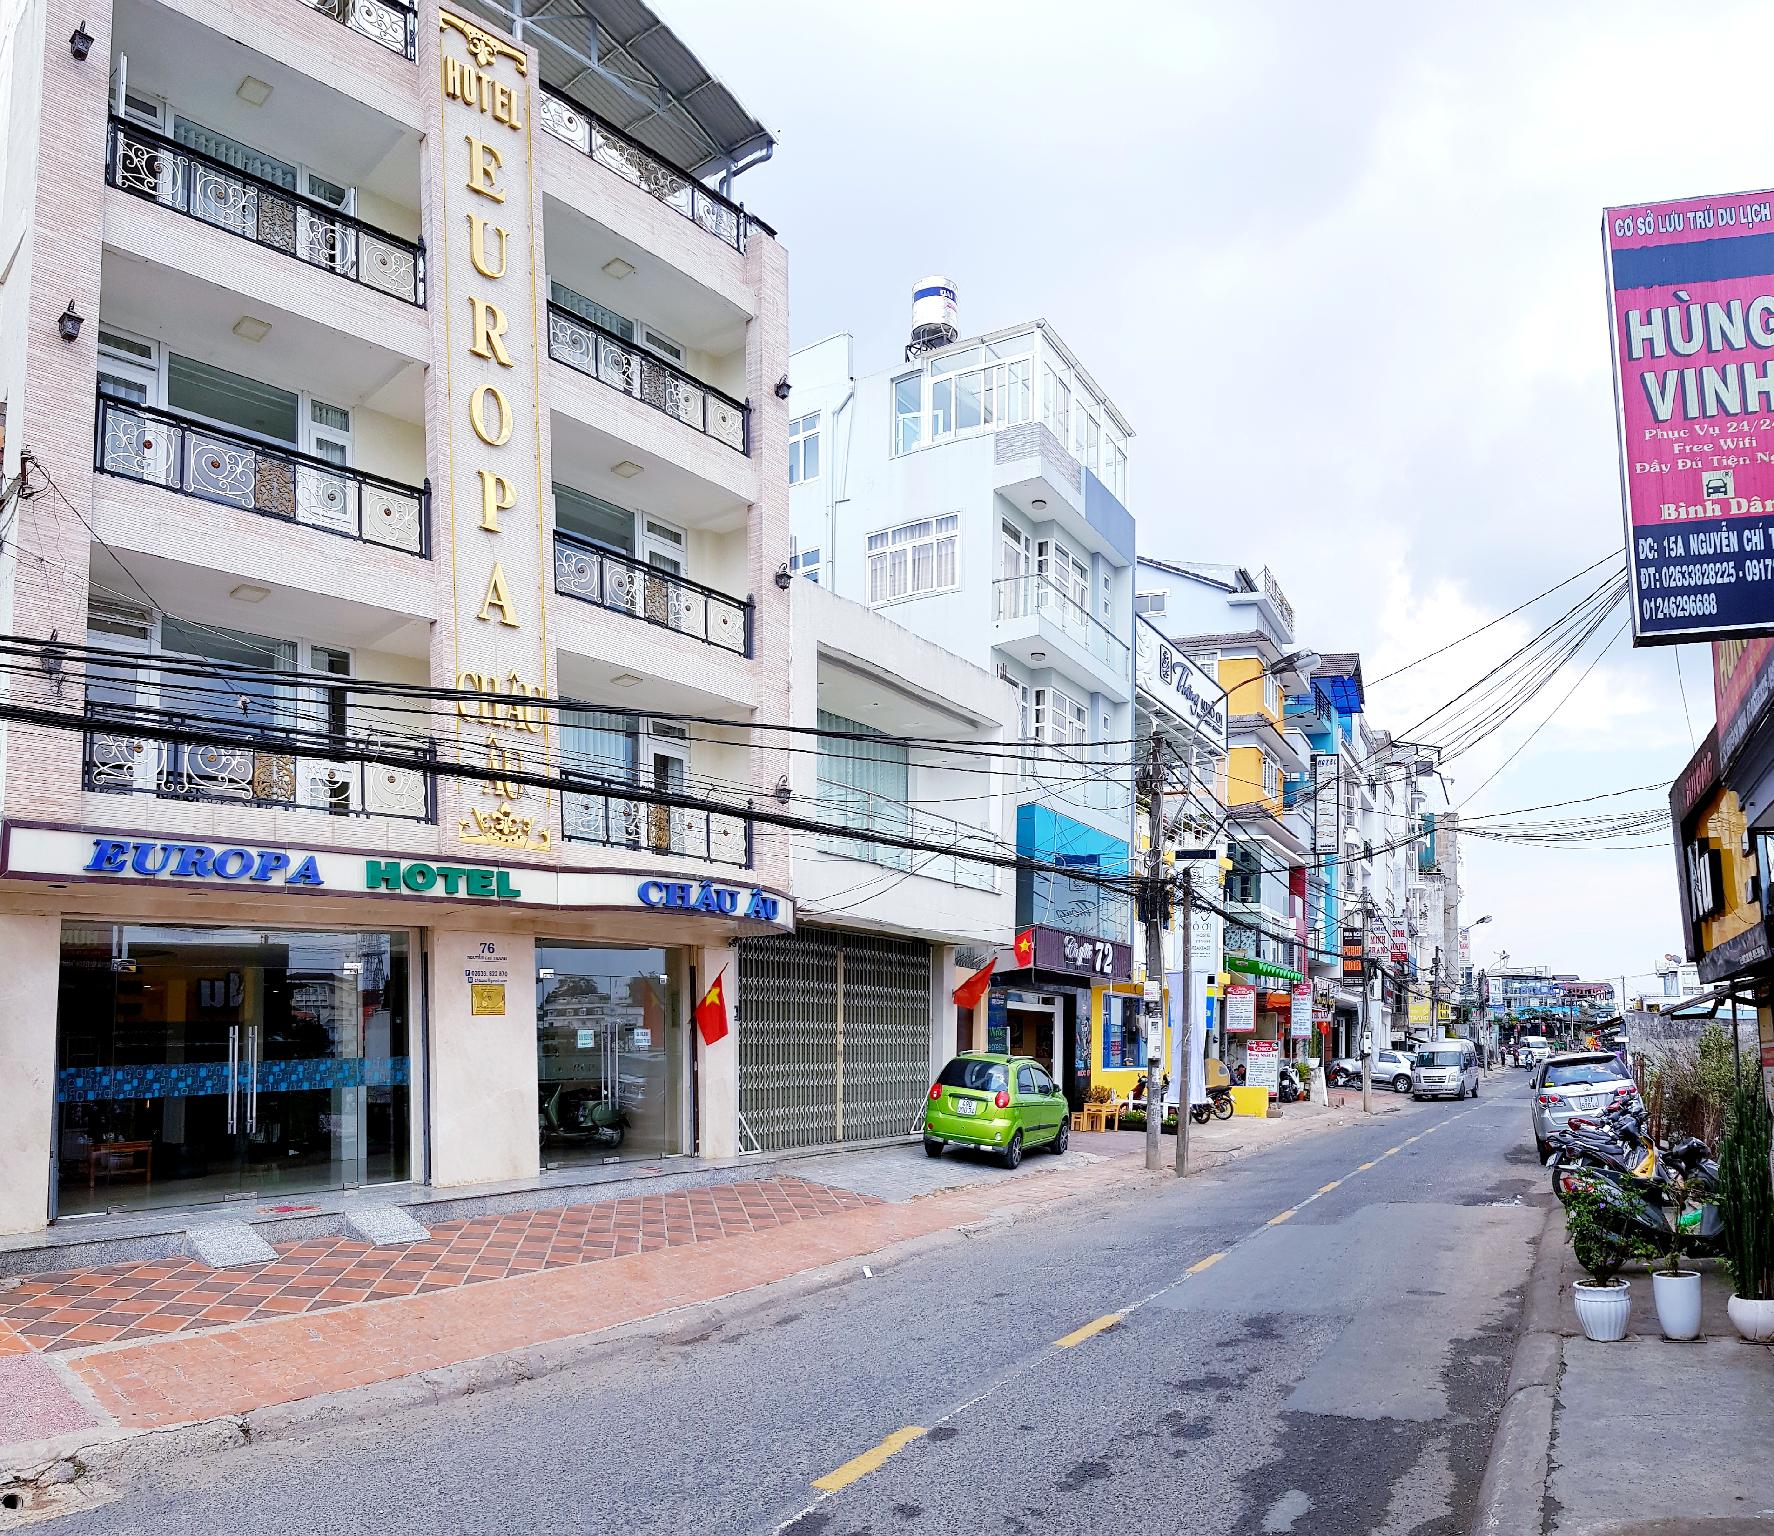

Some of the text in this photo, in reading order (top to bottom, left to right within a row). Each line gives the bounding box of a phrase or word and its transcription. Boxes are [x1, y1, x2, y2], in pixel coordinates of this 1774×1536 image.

[443, 56, 522, 130] HOTEL
[1615, 214, 1634, 237] CƠ
[1687, 204, 1715, 230] TRÚ
[1717, 207, 1736, 226] DU
[1739, 202, 1771, 229] LỊCH
[1626, 290, 1774, 362] HÙNG
[465, 134, 521, 629] EUROPA
[1640, 359, 1774, 423] VINH
[1644, 428, 1690, 441] Phục
[1694, 424, 1721, 437] Vụ
[1673, 436, 1757, 454] Free Wifi
[1708, 454, 1751, 468] Tiện
[1663, 535, 1685, 558] 15A
[1689, 521, 1739, 556] NGUYỄN
[1743, 522, 1765, 552] CHÍ
[1662, 560, 1736, 588] 02633828225
[1745, 558, 1774, 581] 0917
[1643, 592, 1718, 620] 01246296688
[83, 839, 780, 921] EUROPA HOTEL CHÂU ÂU
[480, 942, 495, 954] 76
[1095, 941, 1113, 974] 72
